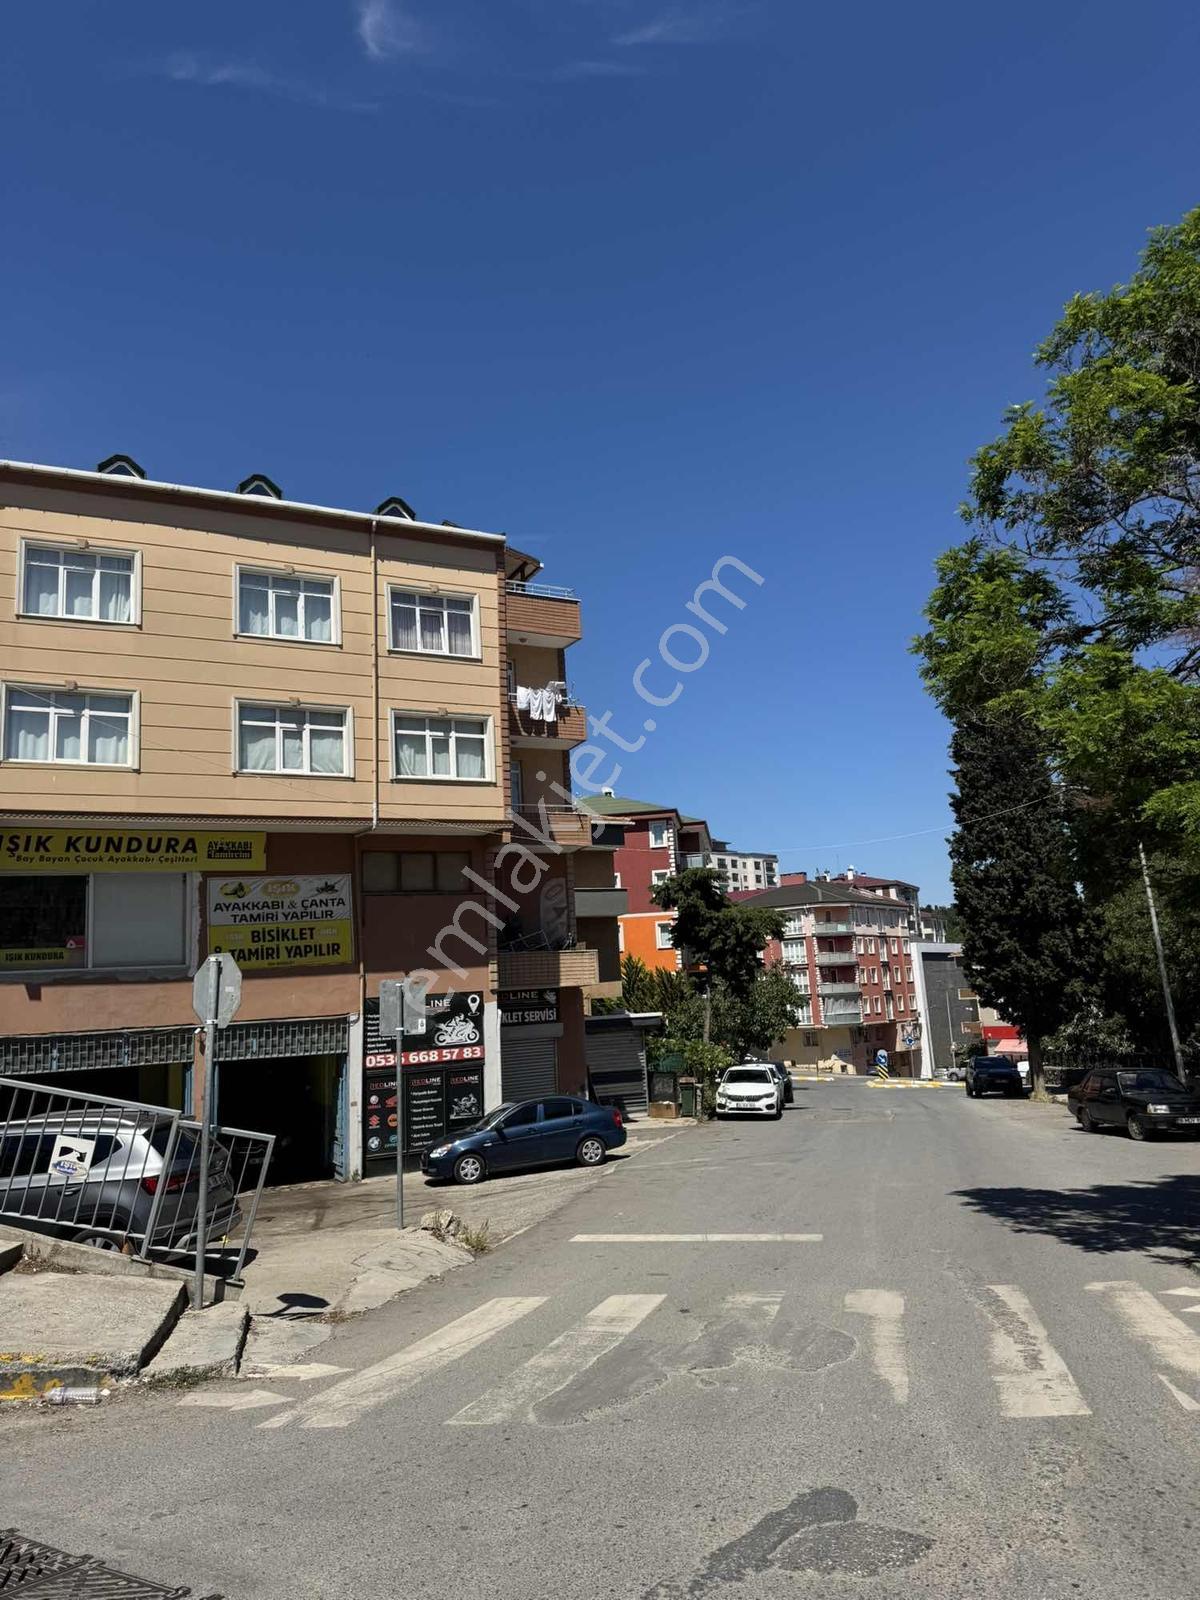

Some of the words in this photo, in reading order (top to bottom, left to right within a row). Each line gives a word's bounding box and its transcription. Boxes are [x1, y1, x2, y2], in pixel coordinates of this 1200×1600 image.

[65, 836, 198, 854] KUNDURA
[16, 855, 34, 864] Bay
[39, 855, 70, 864] Bayan
[75, 855, 104, 864] Çocuk
[108, 856, 155, 864] Ayakkabı
[214, 900, 284, 912] AYAKKABI
[288, 901, 298, 909] &
[301, 898, 346, 910] ÇANTA
[282, 910, 334, 921] YAPILIR
[251, 926, 316, 943] BİSİKLET
[229, 945, 280, 962] TAMİRİ
[285, 943, 341, 958] YAPILIR
[524, 1007, 557, 1022] SERVİSİ
[409, 1050, 439, 1064] 668
[443, 1049, 458, 1061] 57
[463, 1046, 481, 1059] 83
